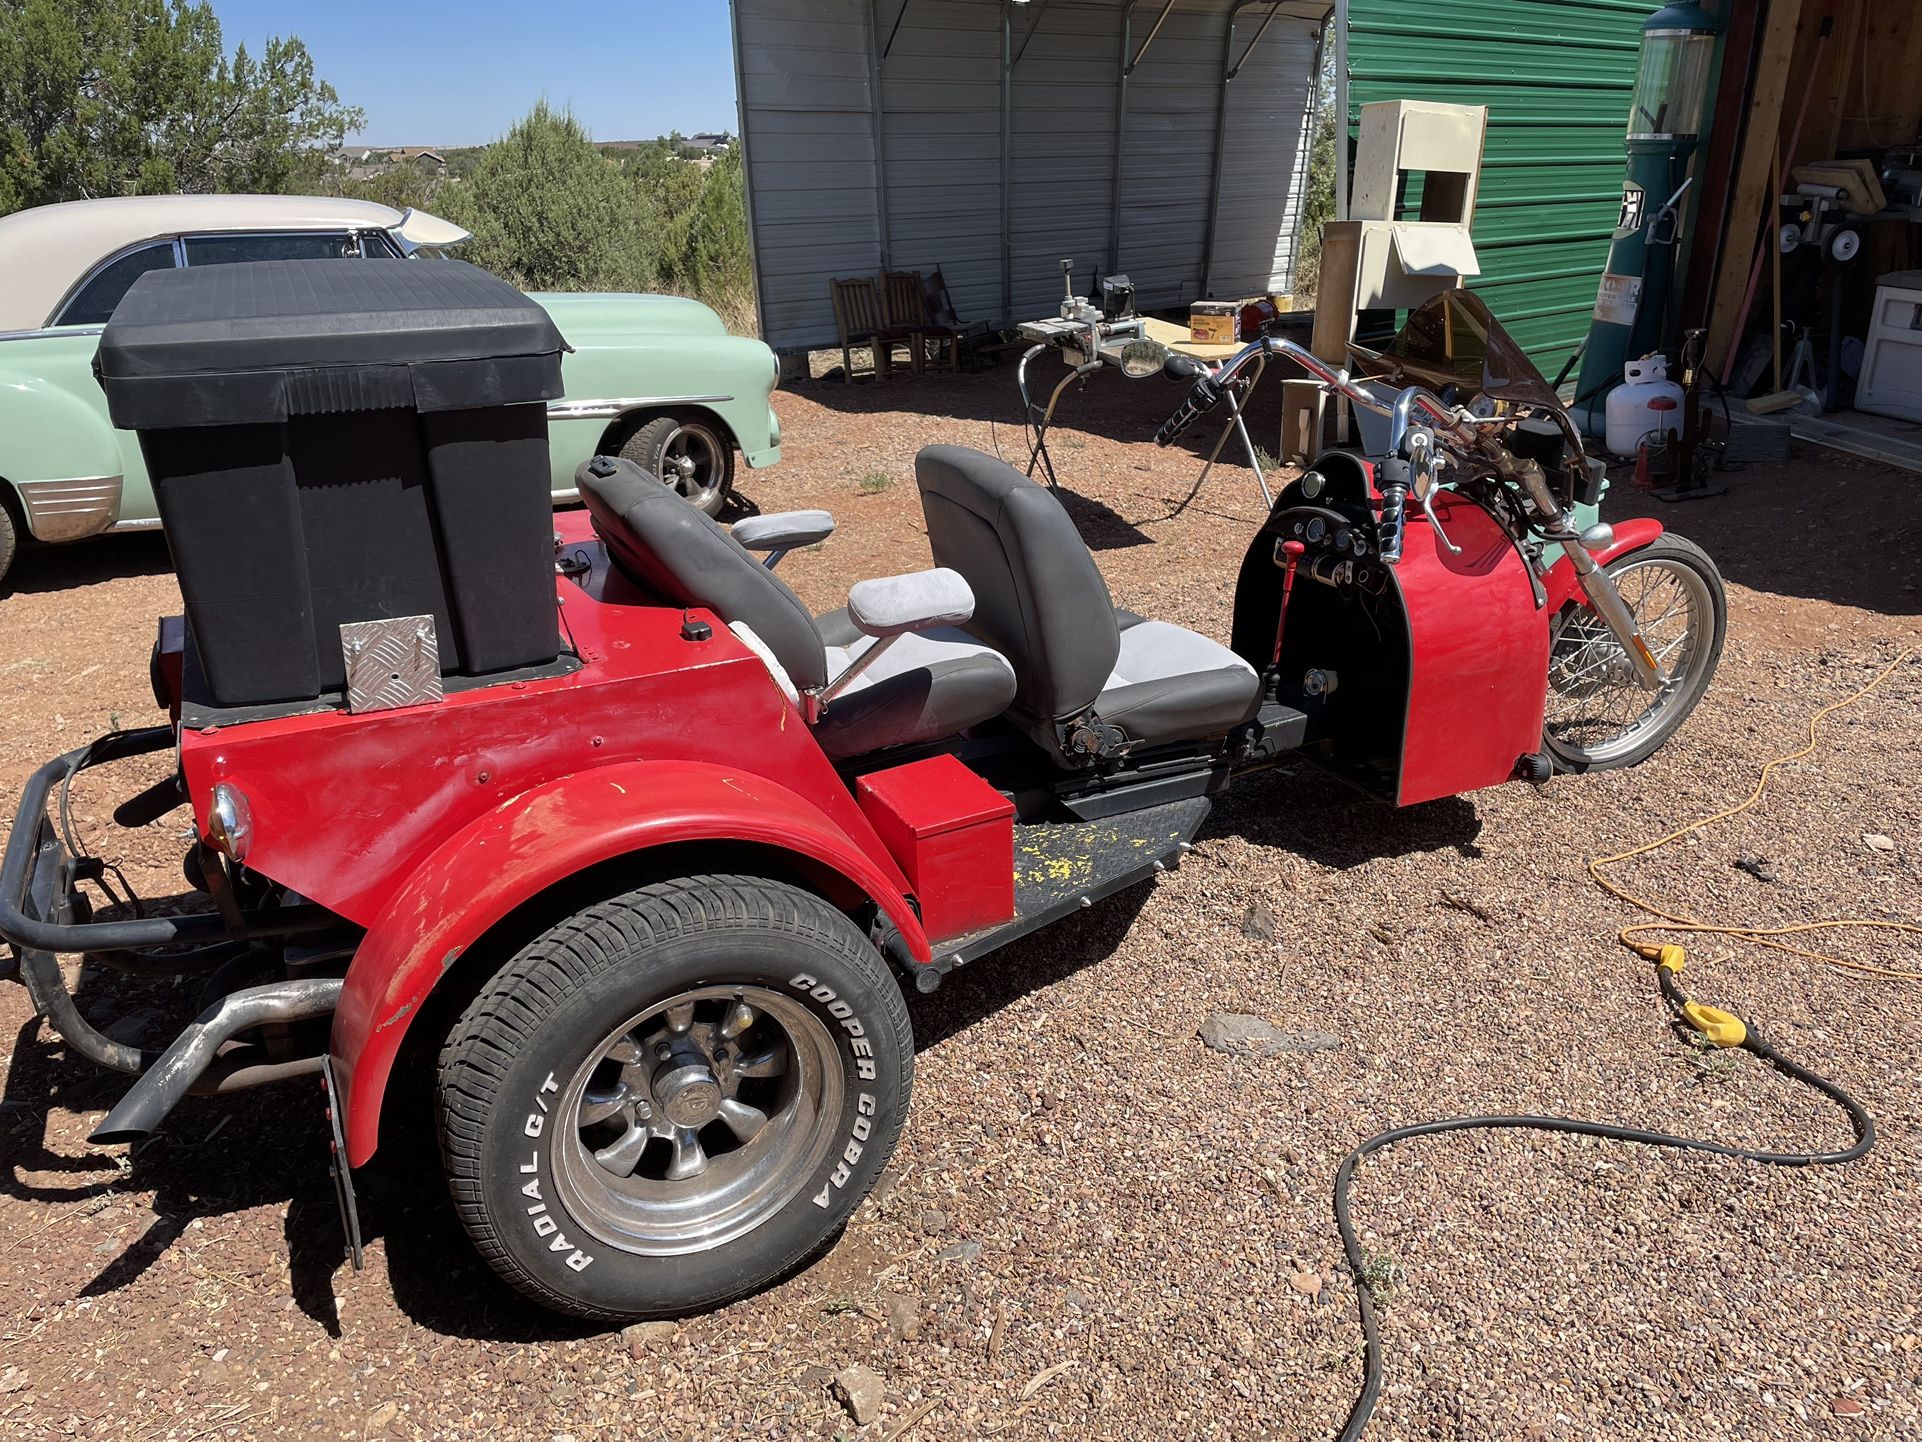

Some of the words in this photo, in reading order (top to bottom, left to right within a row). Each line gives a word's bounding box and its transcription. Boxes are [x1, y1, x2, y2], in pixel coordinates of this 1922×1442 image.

[789, 973, 876, 1080] COOPER
[524, 1071, 559, 1138] G/T
[812, 1093, 876, 1209] COBRA
[520, 1151, 594, 1273] RADIAL
